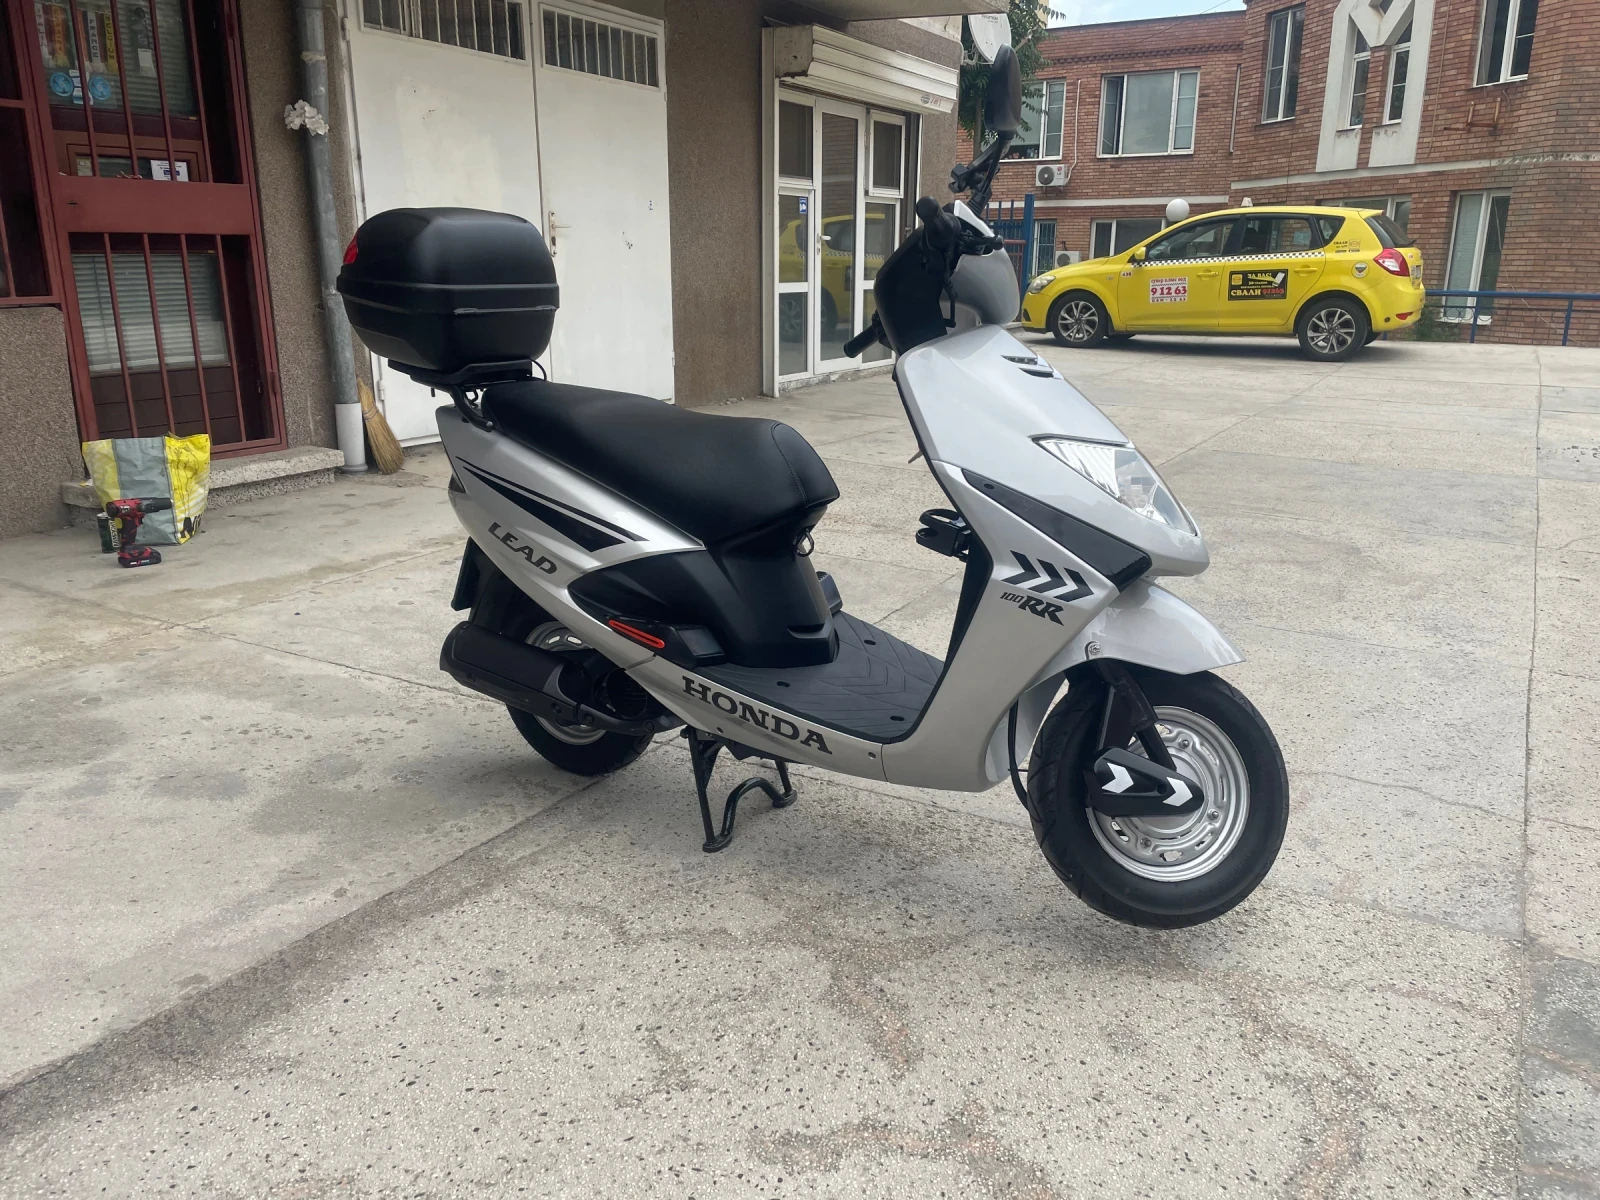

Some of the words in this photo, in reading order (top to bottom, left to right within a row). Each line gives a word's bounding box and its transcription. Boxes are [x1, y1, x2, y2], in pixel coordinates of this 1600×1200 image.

[37, 7, 47, 48] ITALIA
[89, 18, 100, 58] FRANCE
[105, 16, 115, 60] BELGIUM
[1231, 288, 1261, 296] СВАЛИ
[487, 521, 558, 575] LEAD
[682, 675, 833, 755] HONDA
